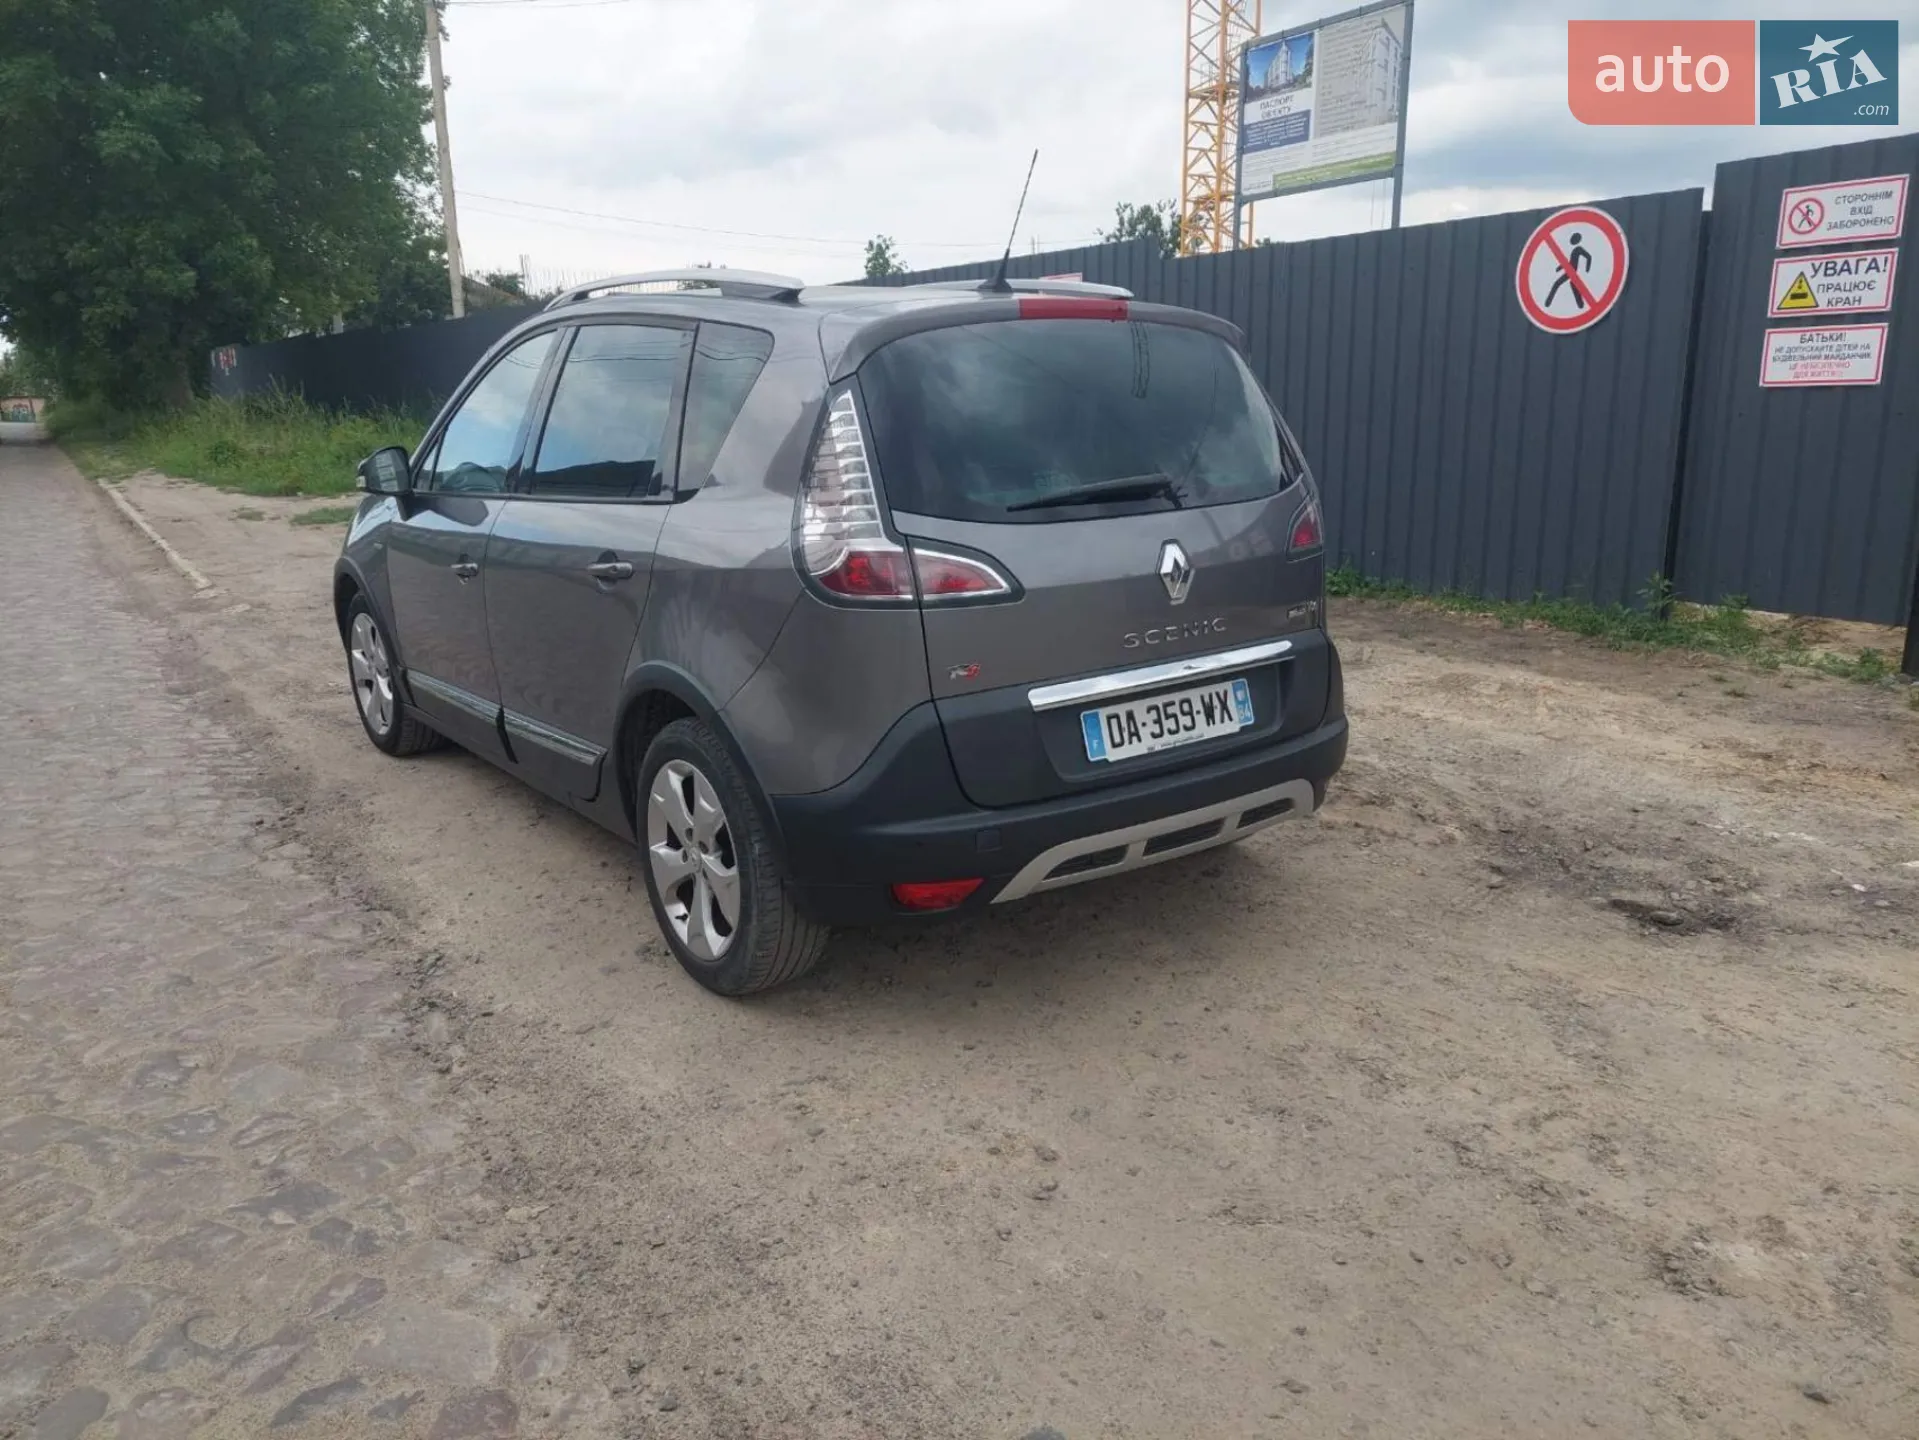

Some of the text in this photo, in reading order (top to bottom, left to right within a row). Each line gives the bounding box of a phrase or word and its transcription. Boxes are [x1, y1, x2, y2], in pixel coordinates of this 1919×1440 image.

[1834, 189, 1893, 205] СТОРОННІМ
[1850, 205, 1873, 216] ВХІД
[1826, 215, 1894, 231] ЗАБОРОНЕНО
[1810, 256, 1889, 279] УВАГА!
[1816, 280, 1877, 294] ПРАЦЮЄ
[1826, 296, 1862, 308] КРАН
[1799, 331, 1847, 344] БАТЬКИ!
[1859, 342, 1871, 351] НА
[1123, 616, 1228, 648] SCENIC
[1105, 688, 1234, 750] DA-359-WX
